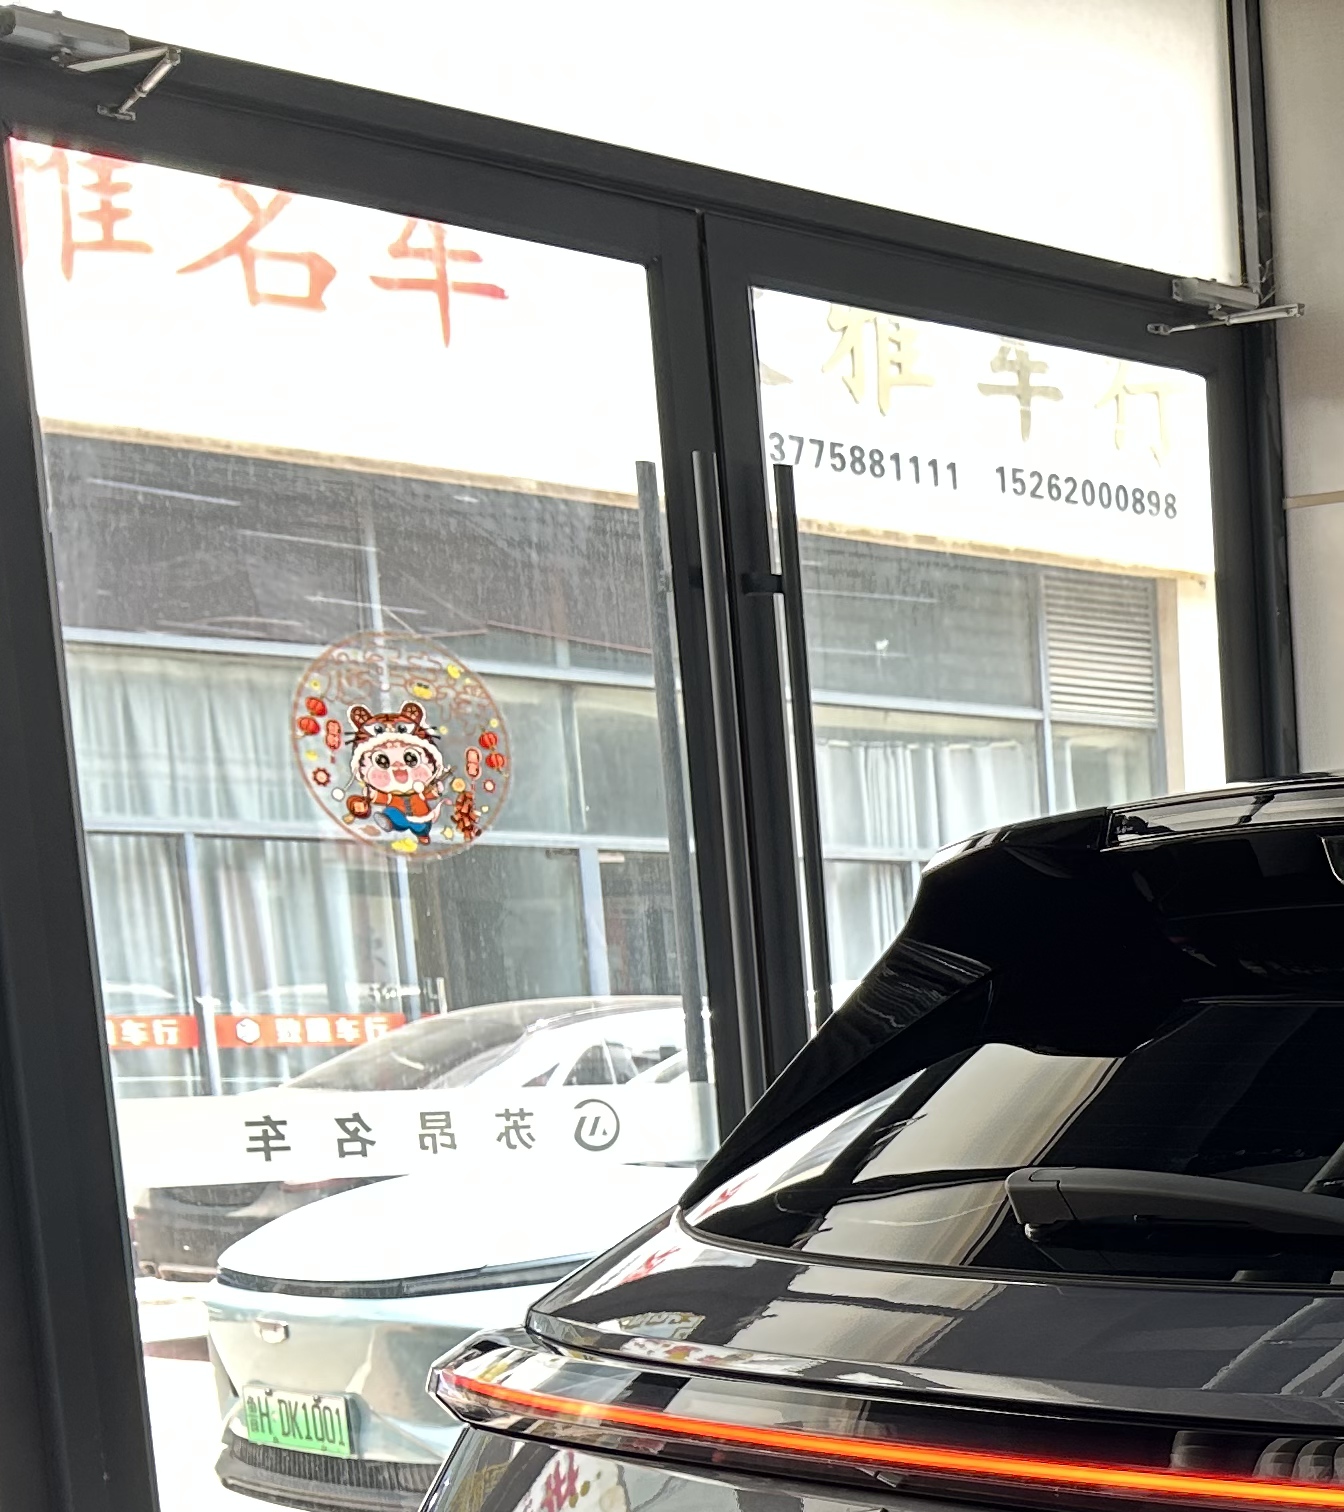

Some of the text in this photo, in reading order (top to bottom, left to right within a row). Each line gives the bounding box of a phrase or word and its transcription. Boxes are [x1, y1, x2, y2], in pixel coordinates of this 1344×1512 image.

[768, 432, 1178, 519] 3775881111 15262000898
[107, 1018, 178, 1046] 车行
